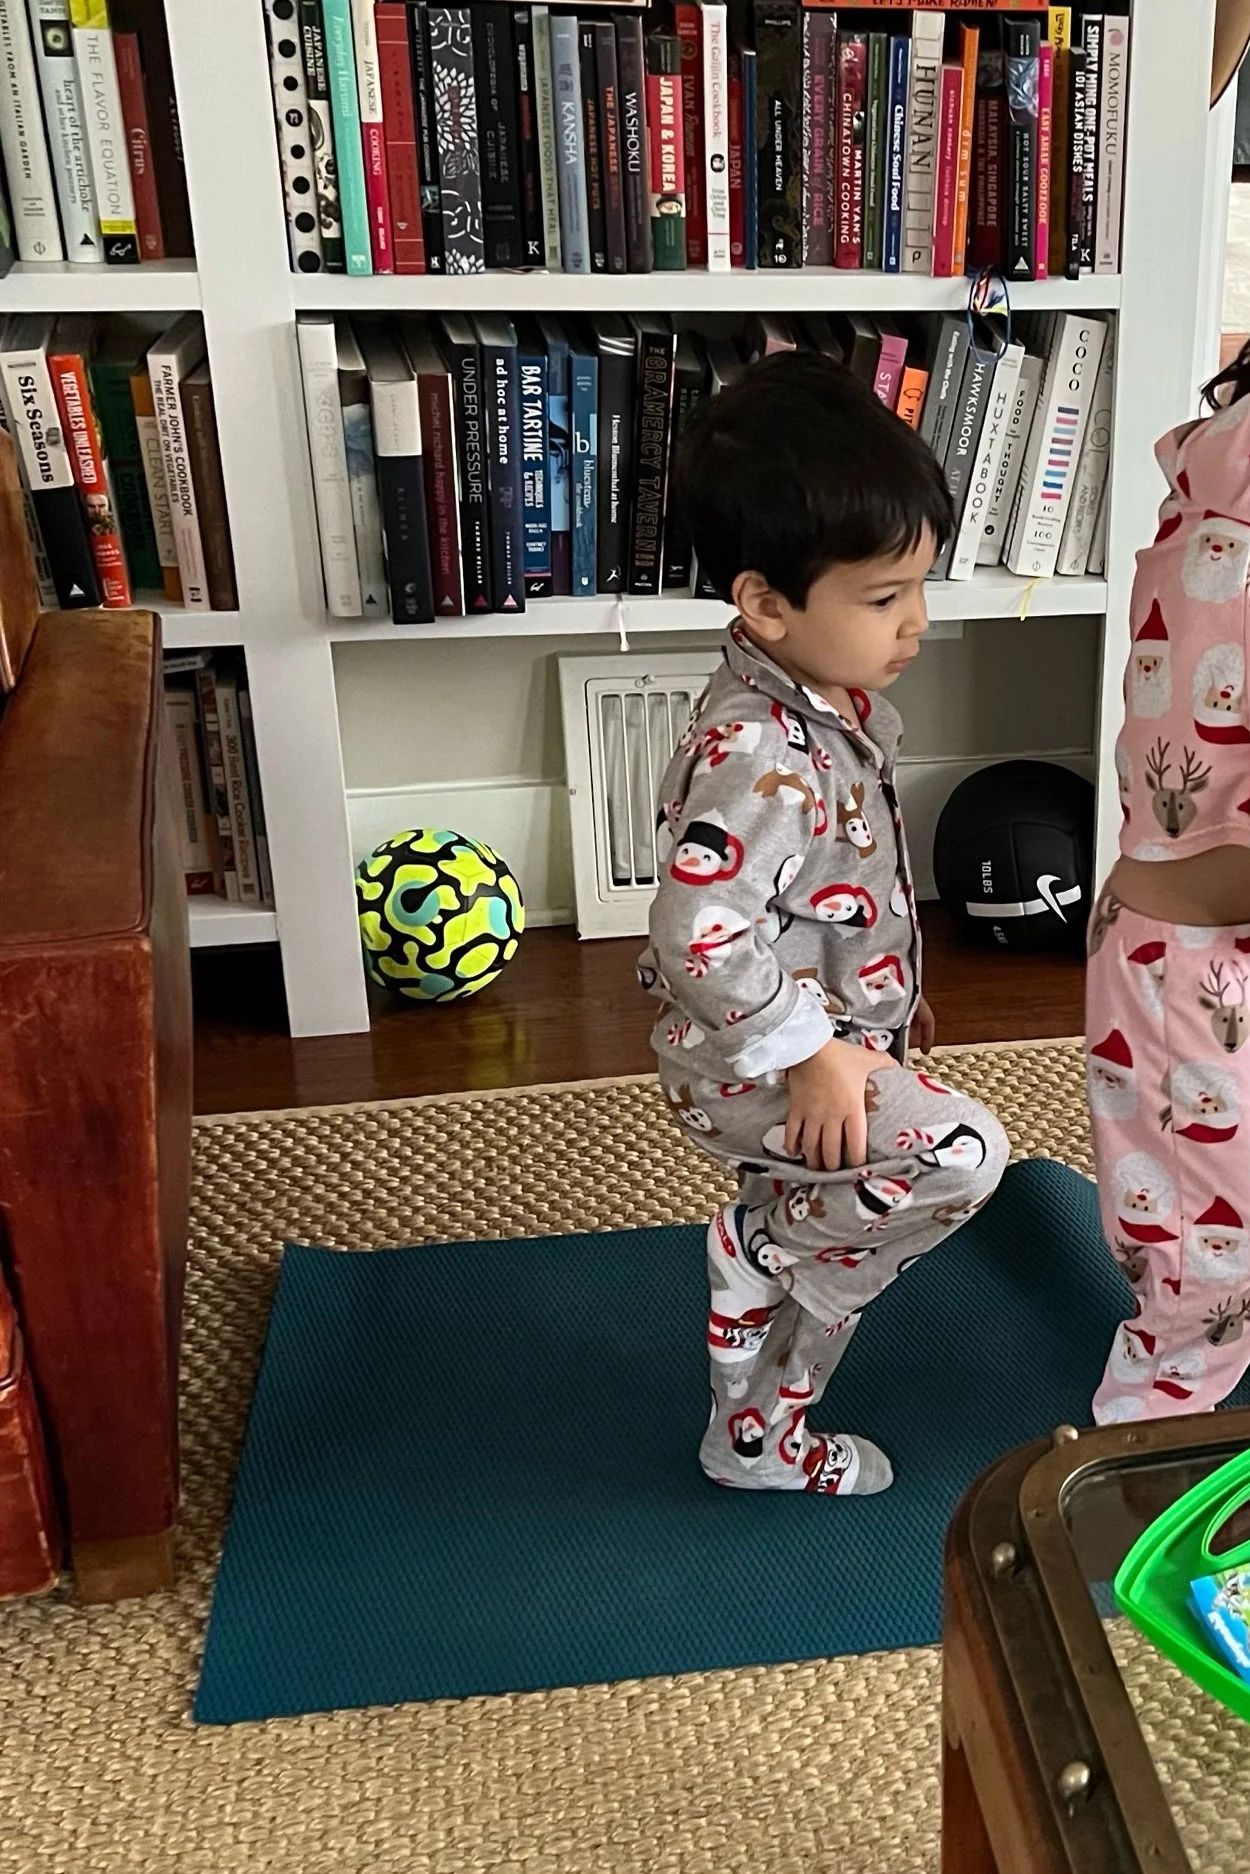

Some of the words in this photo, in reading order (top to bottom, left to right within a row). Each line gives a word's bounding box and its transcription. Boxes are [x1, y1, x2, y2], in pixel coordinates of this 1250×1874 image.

[86, 35, 100, 64] THE
[303, 25, 316, 77] CUISINE
[331, 15, 347, 67] Everyday
[710, 21, 721, 45] The
[1085, 25, 1099, 68] SIMPLY
[311, 25, 327, 92] JAPANESE
[709, 47, 721, 80] Gaijin
[63, 80, 75, 113] heart
[91, 72, 109, 131] FLAVOR
[337, 70, 352, 118] Harumi
[363, 60, 377, 116] JAPANESE
[604, 86, 615, 109] THE
[659, 76, 675, 125] JAPAN
[682, 74, 695, 110] IVAN
[774, 100, 782, 117] ALL
[813, 74, 824, 124] EVERY
[1084, 69, 1098, 106] MING
[1104, 51, 1121, 156] MOMOFUKU
[68, 115, 78, 129] of
[711, 81, 723, 138] Cookbook
[892, 104, 904, 152] Chinese
[911, 64, 936, 170] HUNAN
[986, 100, 999, 160] MALAYSIA,
[1041, 107, 1051, 134] EAST
[1073, 90, 1085, 131] ASIAN
[71, 131, 82, 149] the
[369, 127, 381, 176] COOKING
[561, 101, 578, 165] KANSHA
[606, 111, 618, 174] JAPANESE
[624, 92, 641, 172] WASHOKU
[661, 128, 674, 141] &
[774, 120, 783, 152] UNDER
[813, 127, 824, 174] GRAIN
[840, 92, 852, 178] CHINATOWN
[960, 129, 972, 160] dim
[1022, 132, 1030, 153] HOT
[1071, 132, 1084, 174] DISHES
[1083, 108, 1097, 160] ONE-POT
[20, 140, 32, 179] GARDEN
[100, 139, 121, 216] EQUATION
[661, 143, 677, 192] KOREA
[729, 144, 742, 189] JAPAN
[774, 154, 783, 191] HEAVEN
[852, 149, 863, 201] MARTIN
[891, 153, 902, 180] Soul
[1022, 156, 1030, 182] SOUR
[74, 153, 90, 213] artichoke
[890, 181, 901, 211] Food
[958, 169, 969, 202] sum
[986, 163, 998, 228] SINGAPORE
[1021, 185, 1029, 215] SALTY
[1082, 162, 1095, 202] MEALS
[813, 192, 824, 228] RICE
[839, 181, 851, 244] COOKING
[851, 204, 862, 244] YAN'S
[1021, 217, 1029, 248] SWEET
[1080, 248, 1091, 261] K
[495, 358, 508, 376] ad
[521, 364, 543, 396] BAR
[1067, 329, 1090, 392] COCO
[17, 375, 36, 406] Six
[59, 371, 87, 431] VEGETABLES
[154, 379, 163, 395] THE
[156, 396, 166, 418] REAL
[160, 364, 178, 411] FARMER
[461, 358, 478, 416] UNDER
[495, 378, 508, 405] hoc
[1012, 389, 1026, 425] FOOD
[160, 419, 169, 439] DIRT
[496, 407, 508, 422] at
[521, 398, 545, 462] TARTINE
[610, 414, 621, 444] Heston
[639, 356, 668, 470] GRAMERCY
[955, 361, 986, 457] HAWKSMOOR
[24, 408, 55, 484] Seasons
[163, 439, 171, 451] ON
[168, 413, 184, 454] JOHN'S
[497, 424, 510, 465] home
[72, 430, 97, 485] UNLEASHED
[146, 437, 163, 491] CLEAN
[164, 453, 179, 503] VEGETABLES
[465, 420, 483, 504] PRESSURE
[610, 444, 621, 492] Blumenthal
[969, 391, 1008, 524] HUXTABOOK
[994, 442, 1014, 505] THOUGHT
[174, 456, 193, 517] COOKBOOK
[523, 480, 534, 508] RECIPES
[583, 459, 595, 508] bluestem
[154, 492, 171, 537] START
[397, 487, 408, 541] ALINEA
[438, 517, 449, 534] the
[611, 501, 620, 525] home
[635, 475, 662, 551] TAVERN
[1042, 504, 1054, 514] 10
[440, 535, 451, 576] kitchen
[1033, 530, 1052, 541] 100
[233, 802, 248, 839] Cooker
